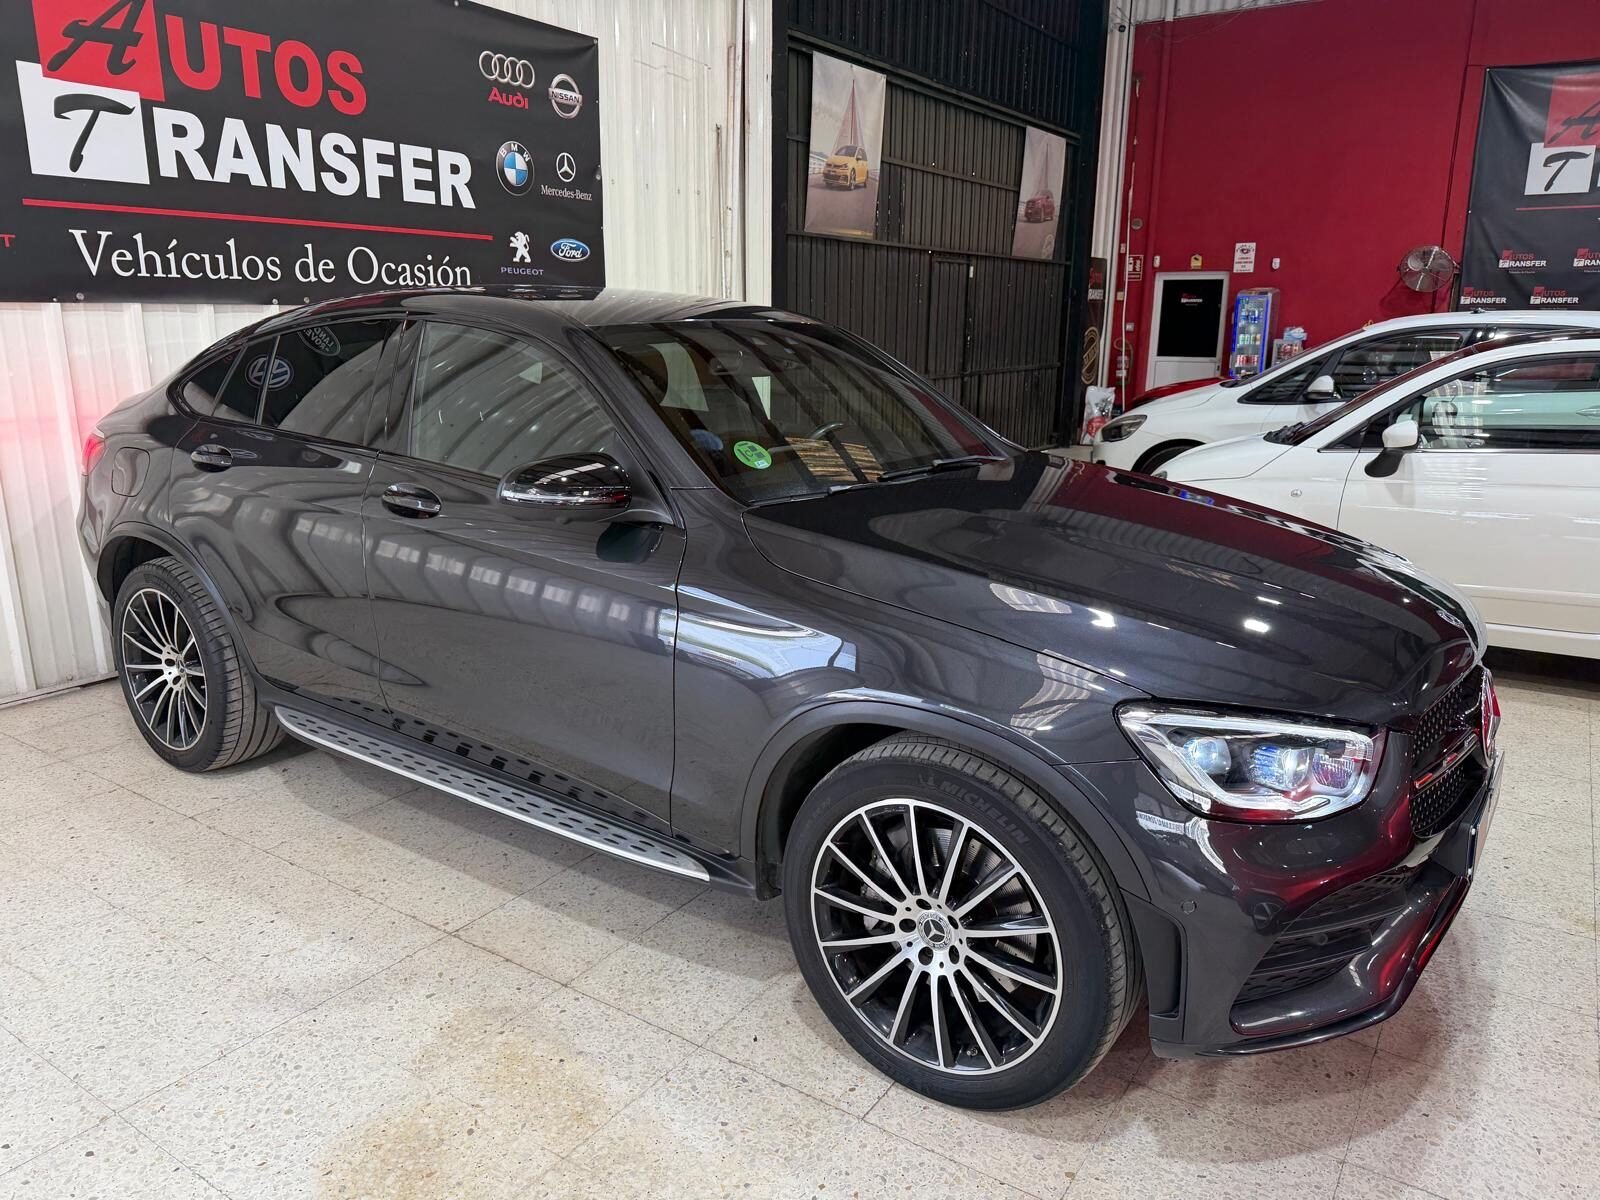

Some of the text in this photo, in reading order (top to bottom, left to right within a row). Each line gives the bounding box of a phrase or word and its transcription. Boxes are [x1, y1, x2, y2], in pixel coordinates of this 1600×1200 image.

[488, 87, 529, 110] Audi
[551, 90, 580, 104] NISSAN
[54, 93, 477, 210] TRANSFER
[500, 143, 531, 162] BMW
[540, 184, 593, 201] Mercedes-Benz
[68, 229, 472, 287] Vehículos de Ocasión
[558, 242, 584, 258] Ford
[500, 266, 544, 276] PEUGEOT
[940, 780, 1031, 845] MICHELIN
